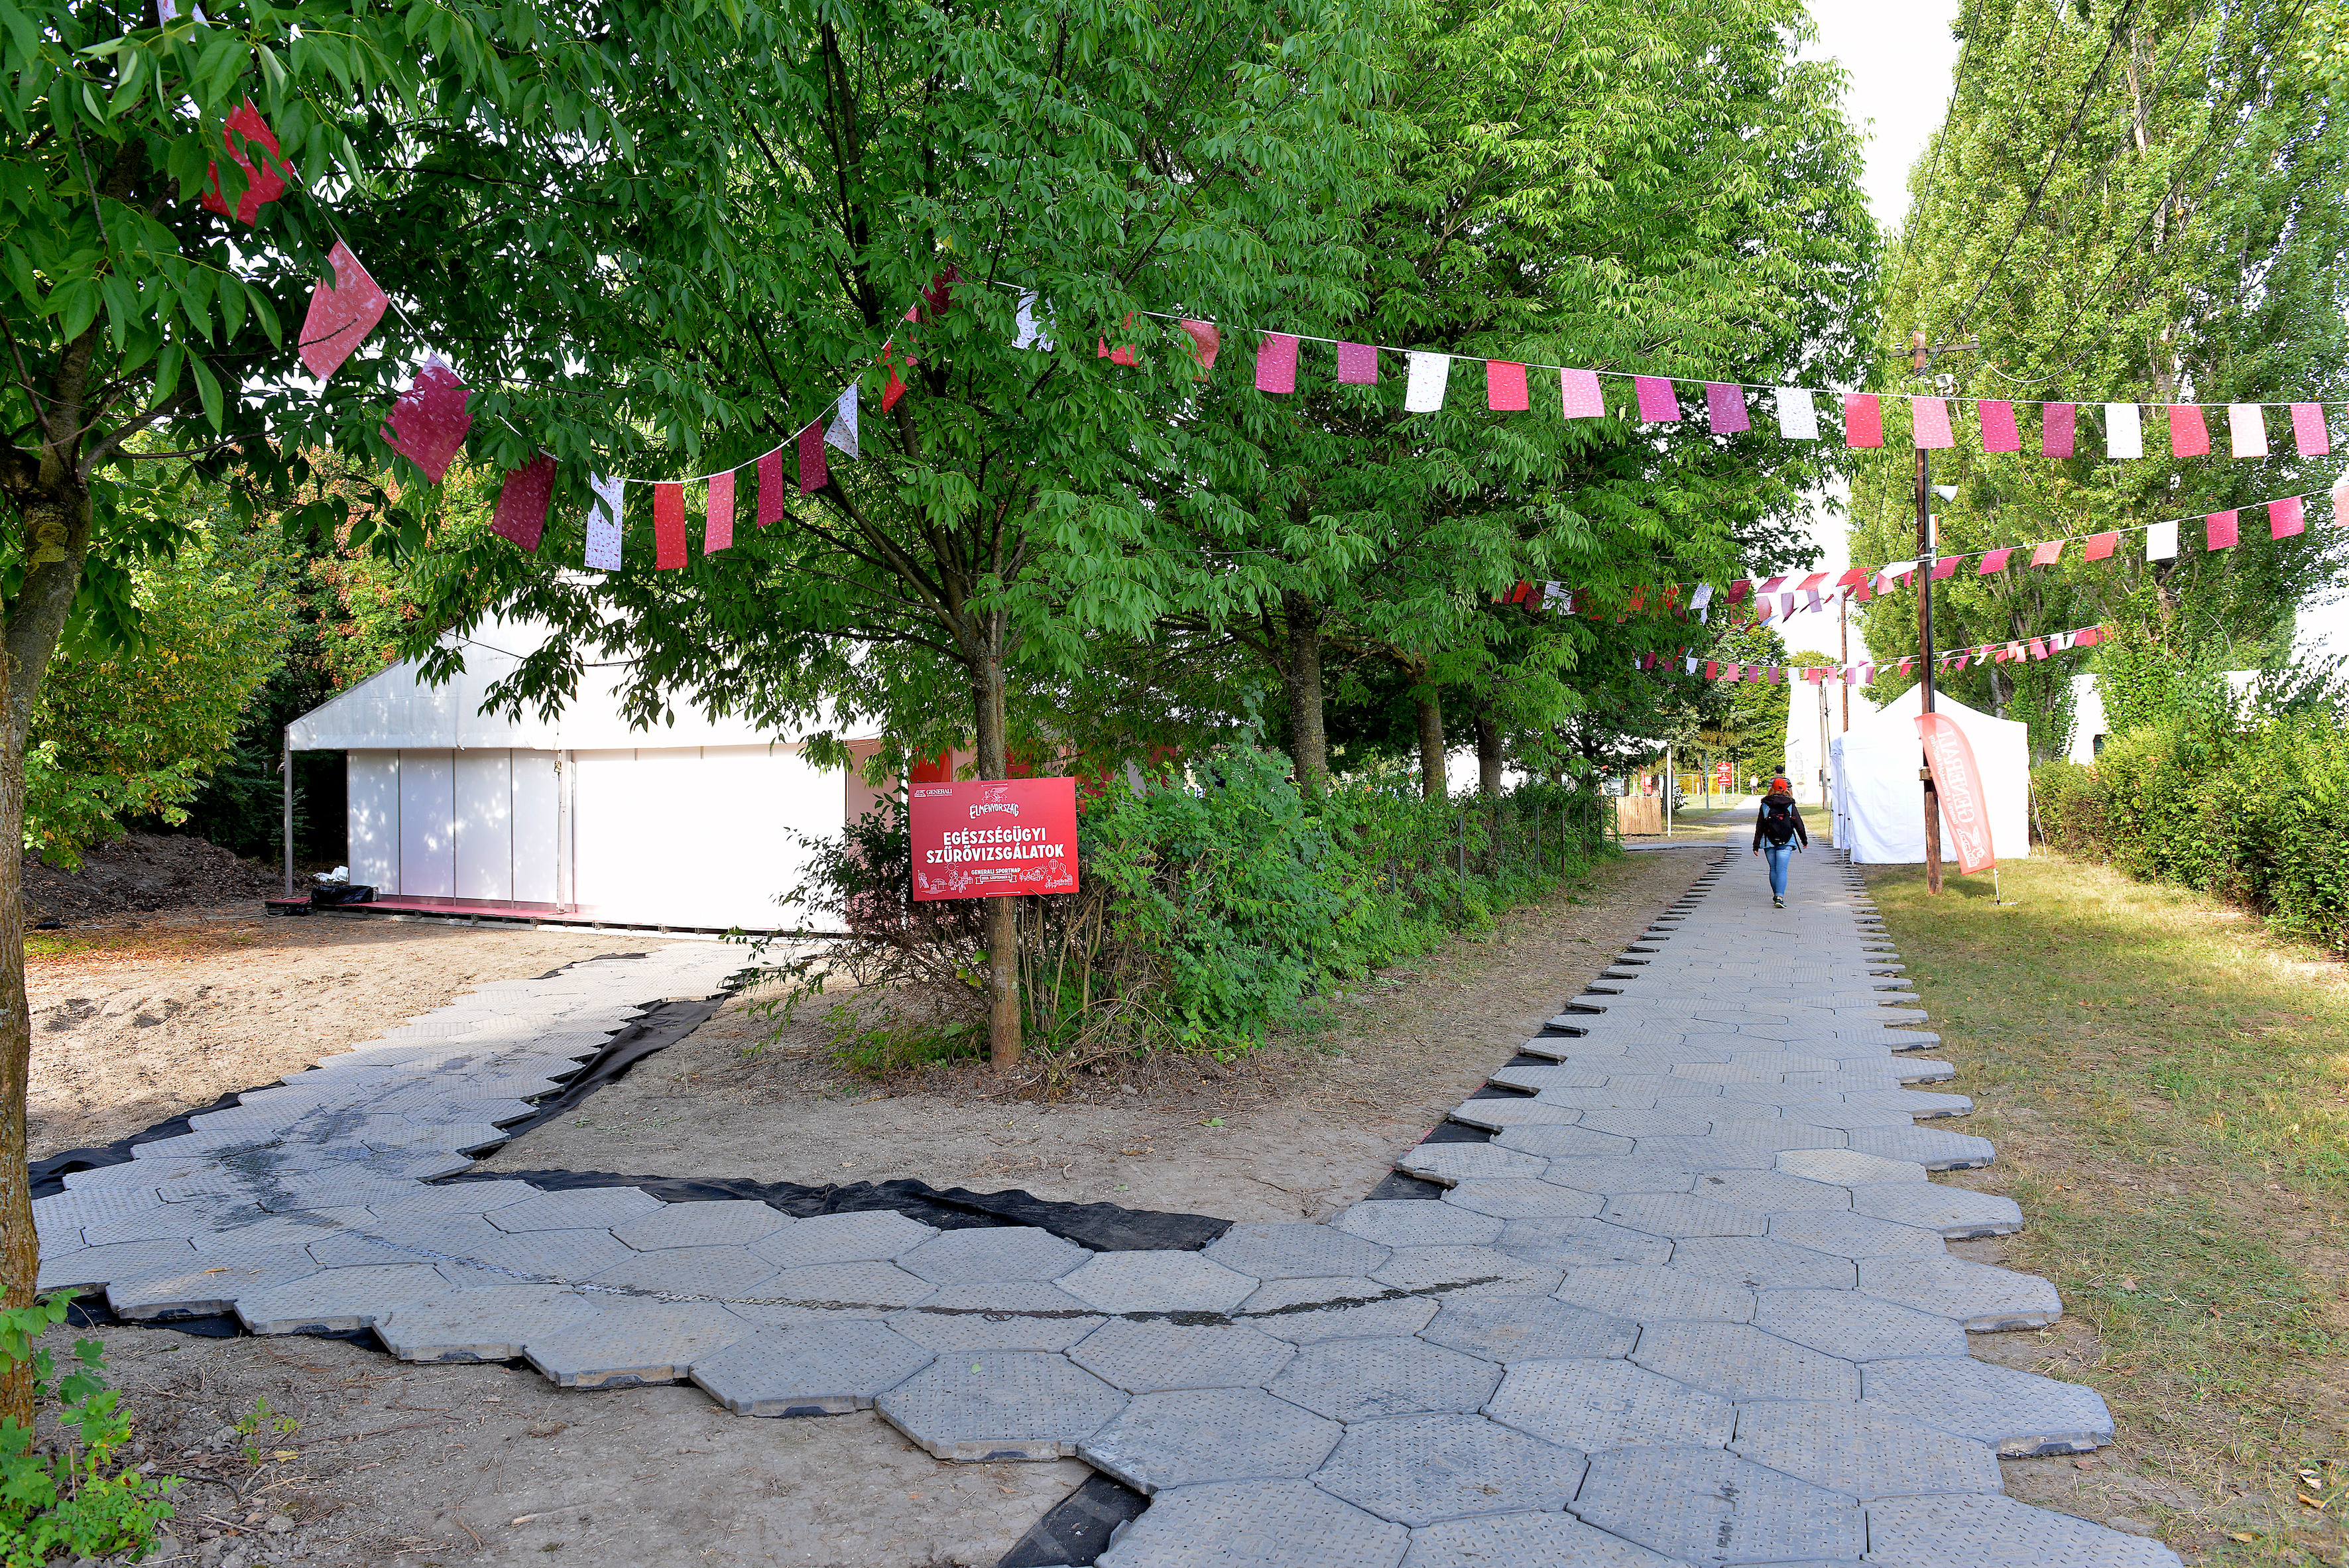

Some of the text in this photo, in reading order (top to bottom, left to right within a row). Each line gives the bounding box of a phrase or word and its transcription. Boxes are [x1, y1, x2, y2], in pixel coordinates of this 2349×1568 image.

[969, 803, 1020, 819] ÉLMÉNYORSZÁG
[943, 825, 1046, 846] EGÉSZSÉGÜGYI
[926, 842, 1065, 863] SZŰRŐVIZSGÁLATOK
